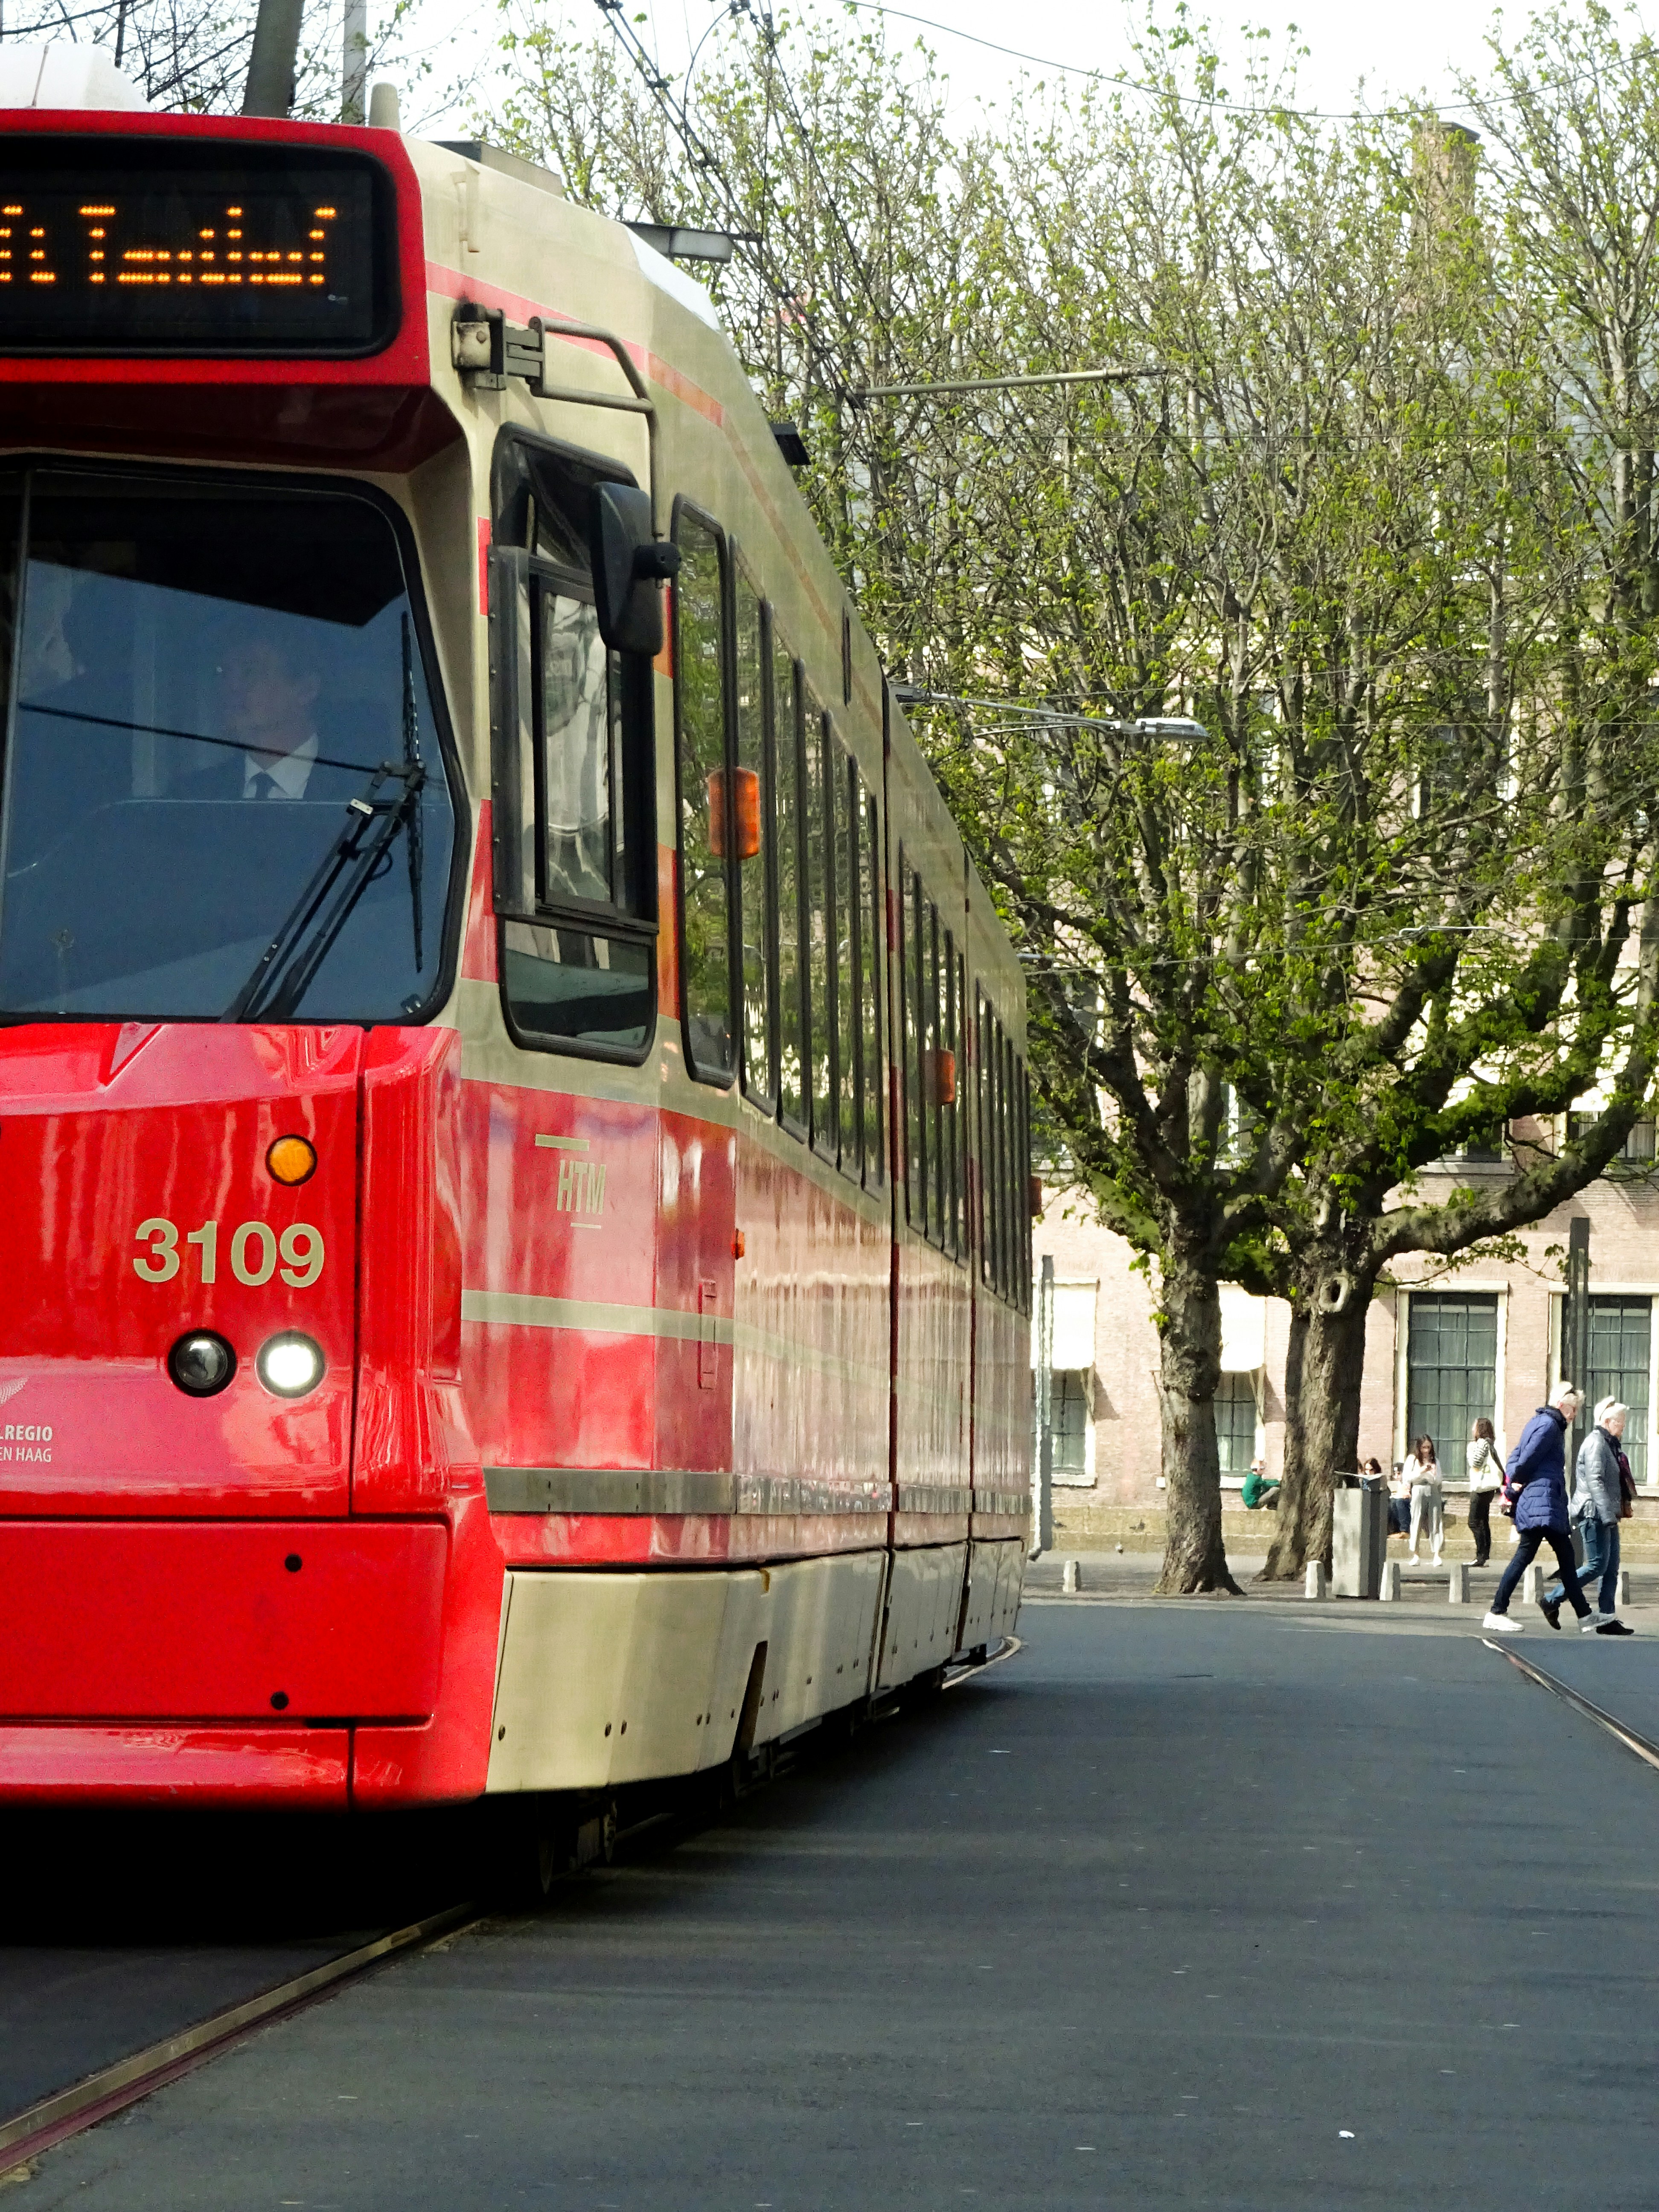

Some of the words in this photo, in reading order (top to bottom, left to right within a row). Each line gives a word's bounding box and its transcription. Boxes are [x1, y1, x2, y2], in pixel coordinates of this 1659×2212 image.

[557, 1160, 606, 1214] HTM
[133, 1218, 324, 1288] 3109
[16, 1447, 52, 1463] HAAG
